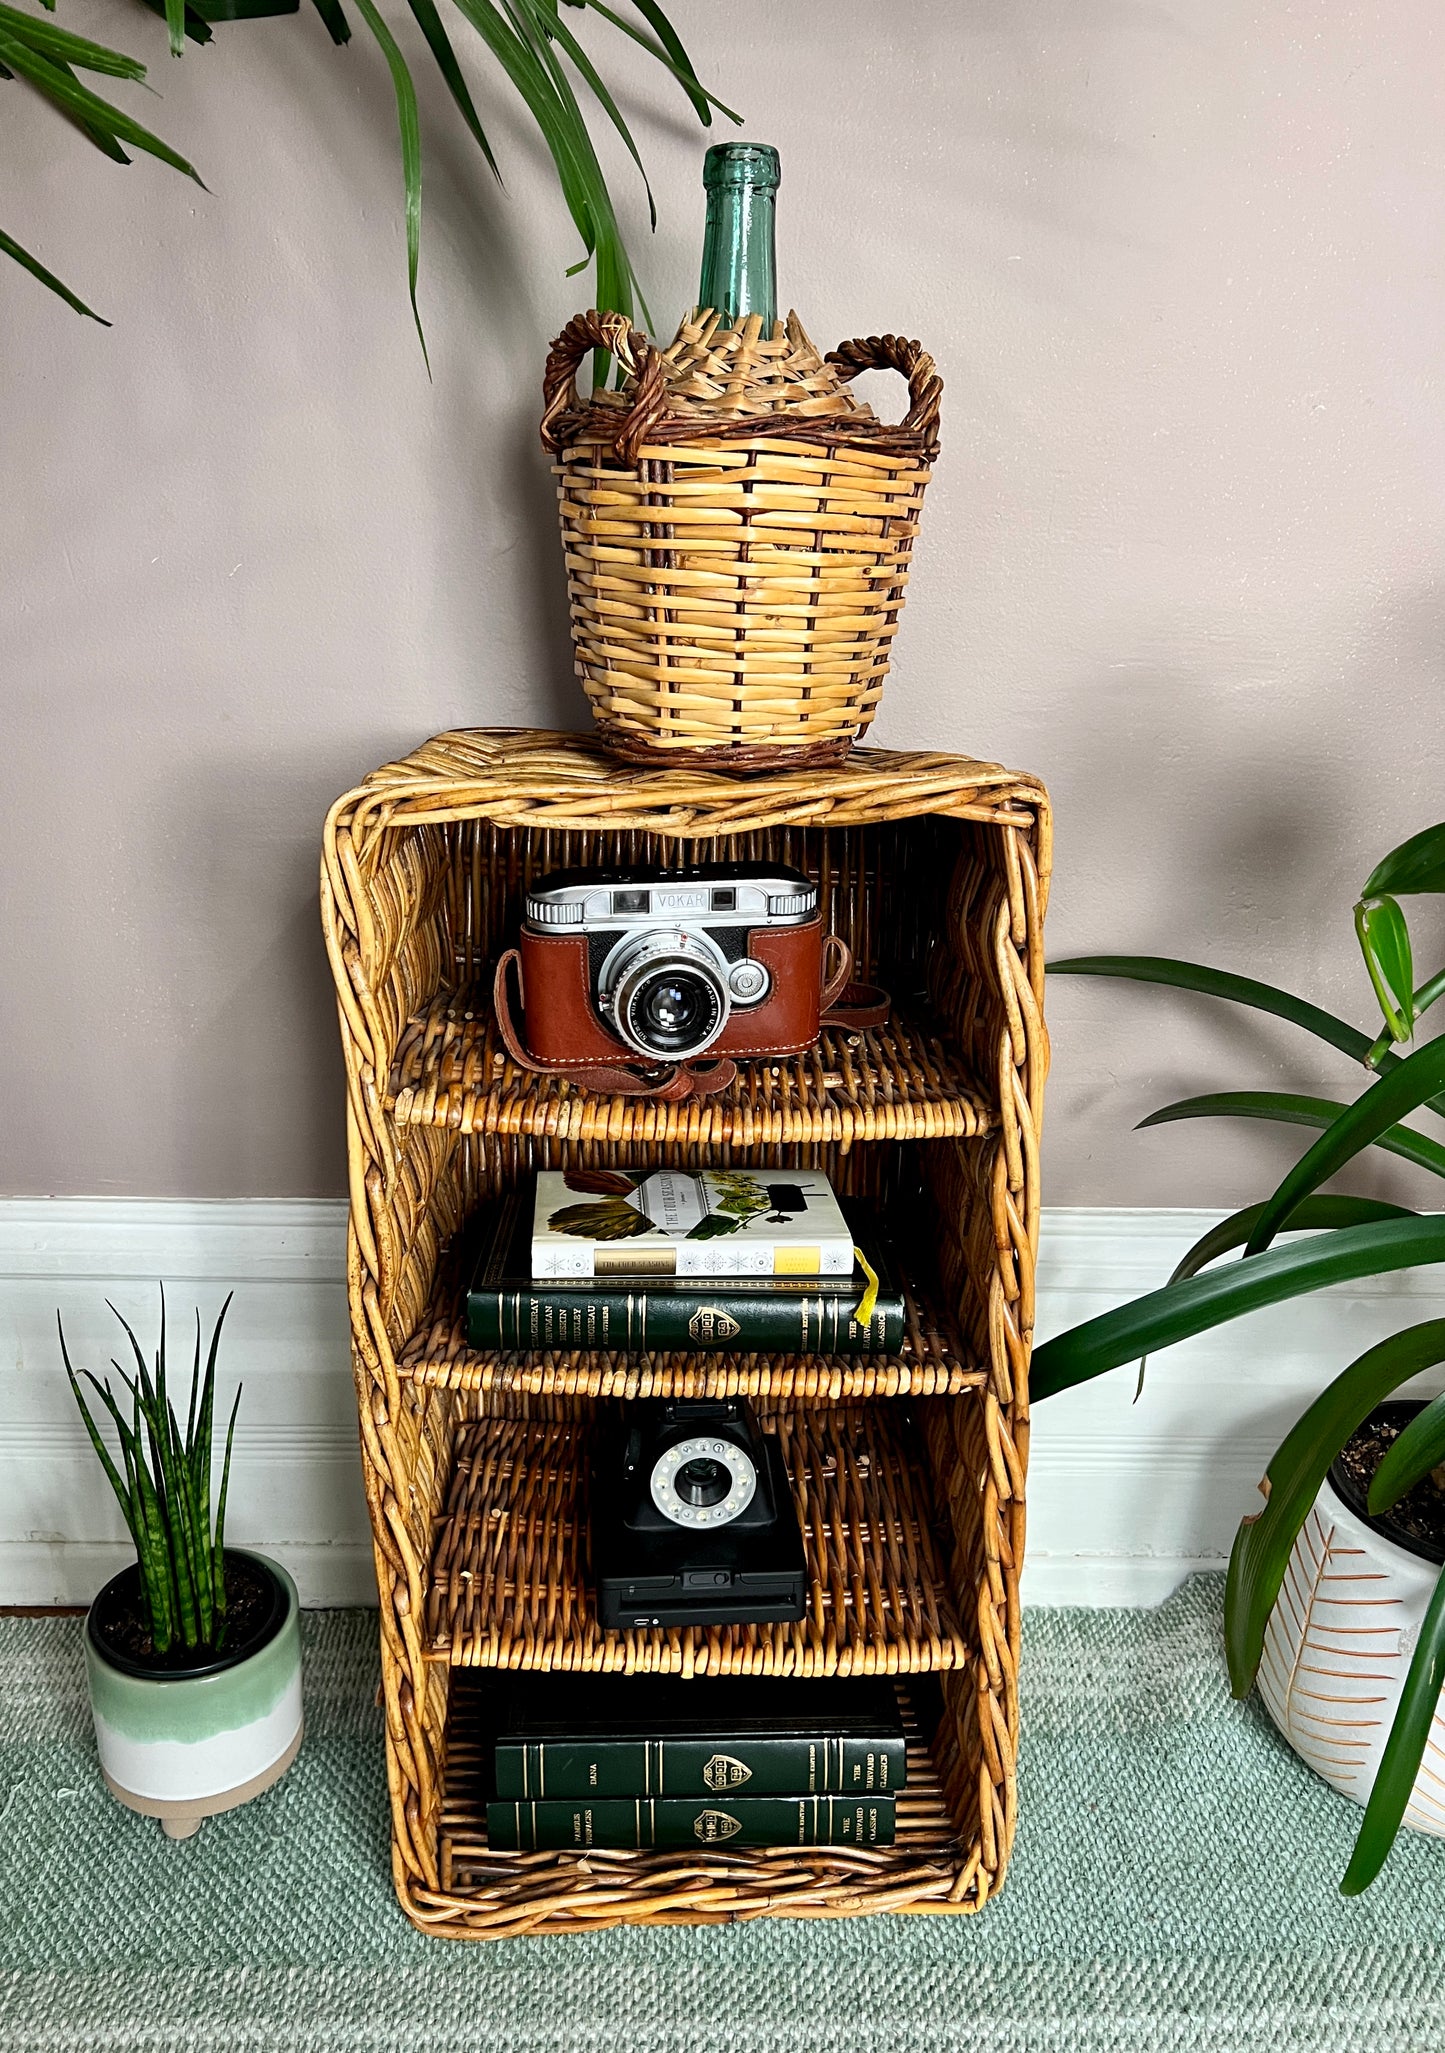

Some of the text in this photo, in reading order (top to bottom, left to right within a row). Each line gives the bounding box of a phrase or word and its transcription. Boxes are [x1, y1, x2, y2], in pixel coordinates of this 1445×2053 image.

[658, 893, 704, 907] VOKAR
[631, 991, 641, 1017] VOKAR
[704, 984, 717, 1005] MADE
[710, 1008, 717, 1016] IN
[660, 1175, 679, 1225] THE FOUR SEASONS
[544, 1305, 553, 1344] NEWMAN
[559, 1308, 567, 1341] RUSKIN
[573, 1307, 581, 1342] HUXLEY
[587, 1305, 596, 1344] THOREAU
[849, 1320, 857, 1339] THE
[863, 1324, 871, 1349] HARV
[877, 1310, 886, 1348] CLASSICS
[589, 1763, 597, 1785] DANA
[853, 1764, 861, 1781] THE
[866, 1753, 875, 1789] HARVARD
[880, 1754, 888, 1788] CLASSICS
[573, 1813, 581, 1842] FAMOUS
[584, 1809, 593, 1845] PREFACES
[856, 1807, 864, 1841] HARVARD
[868, 1808, 877, 1841] CLASSICS
